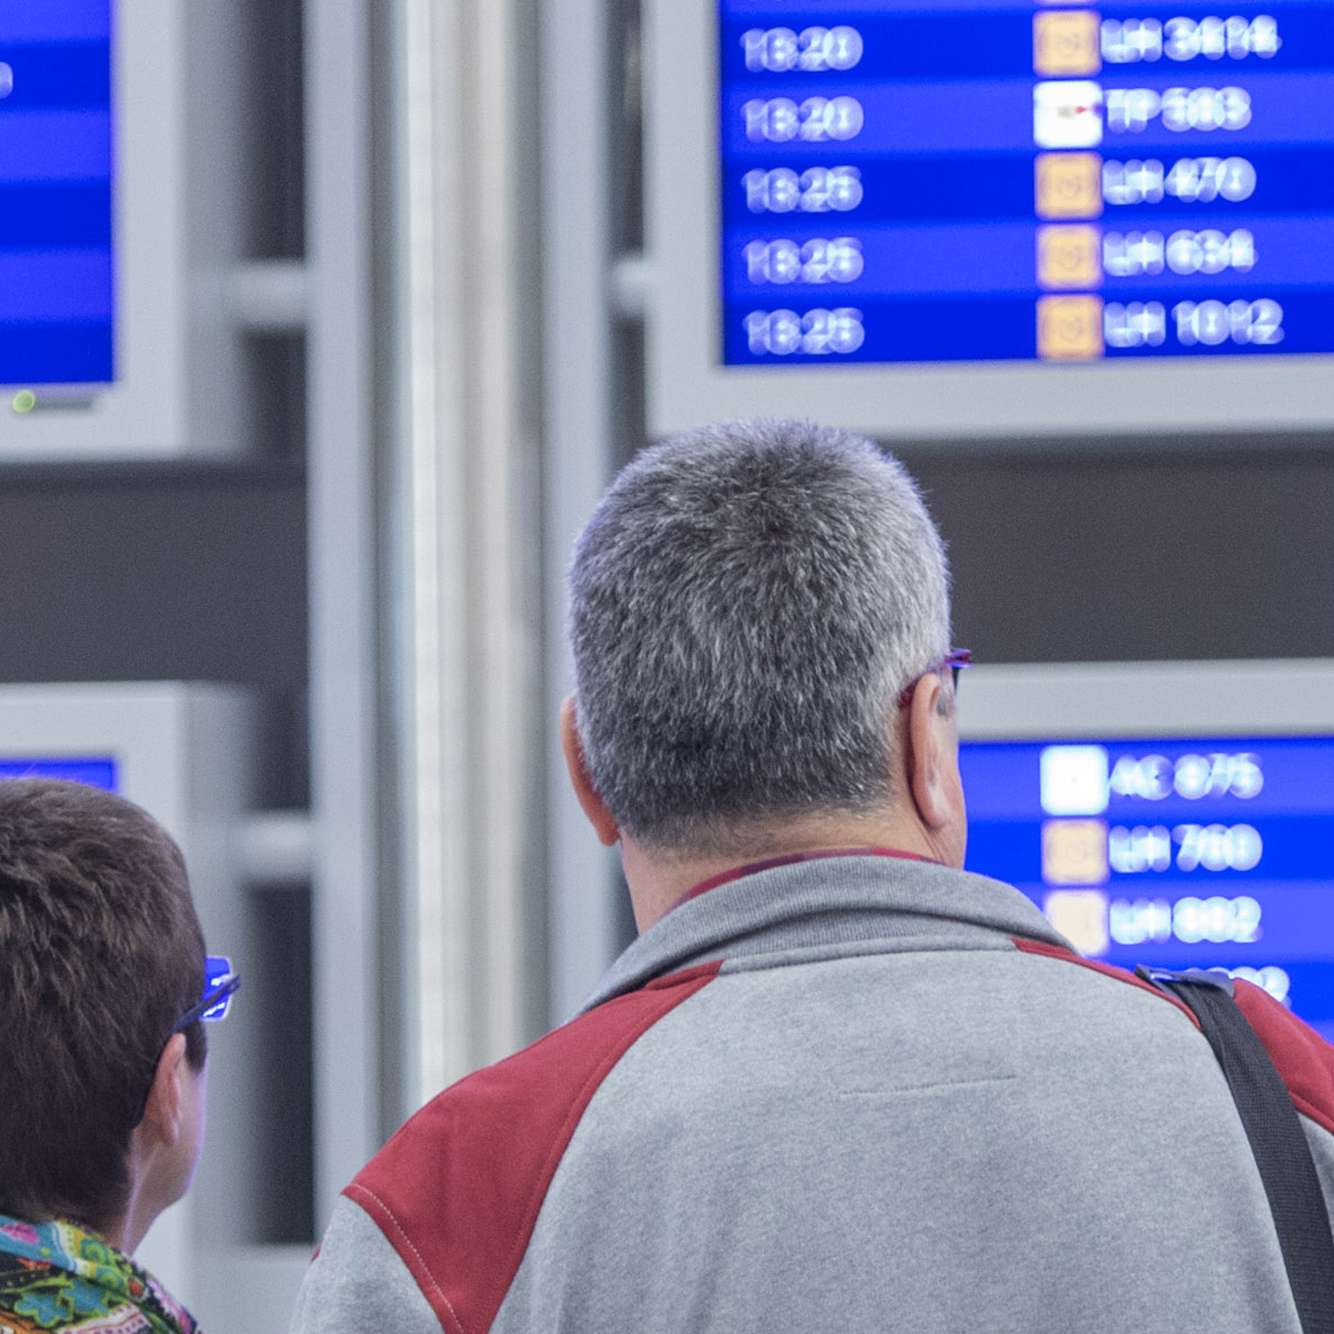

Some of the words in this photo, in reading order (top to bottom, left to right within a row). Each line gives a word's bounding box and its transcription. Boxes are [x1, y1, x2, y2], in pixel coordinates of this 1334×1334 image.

[1102, 24, 1160, 60] LH
[1101, 90, 1163, 127] TP
[1104, 166, 1162, 202] LH
[1105, 237, 1162, 274] LH
[1104, 308, 1163, 345] LH
[1109, 833, 1169, 871] LH
[1109, 903, 1172, 943] LH
